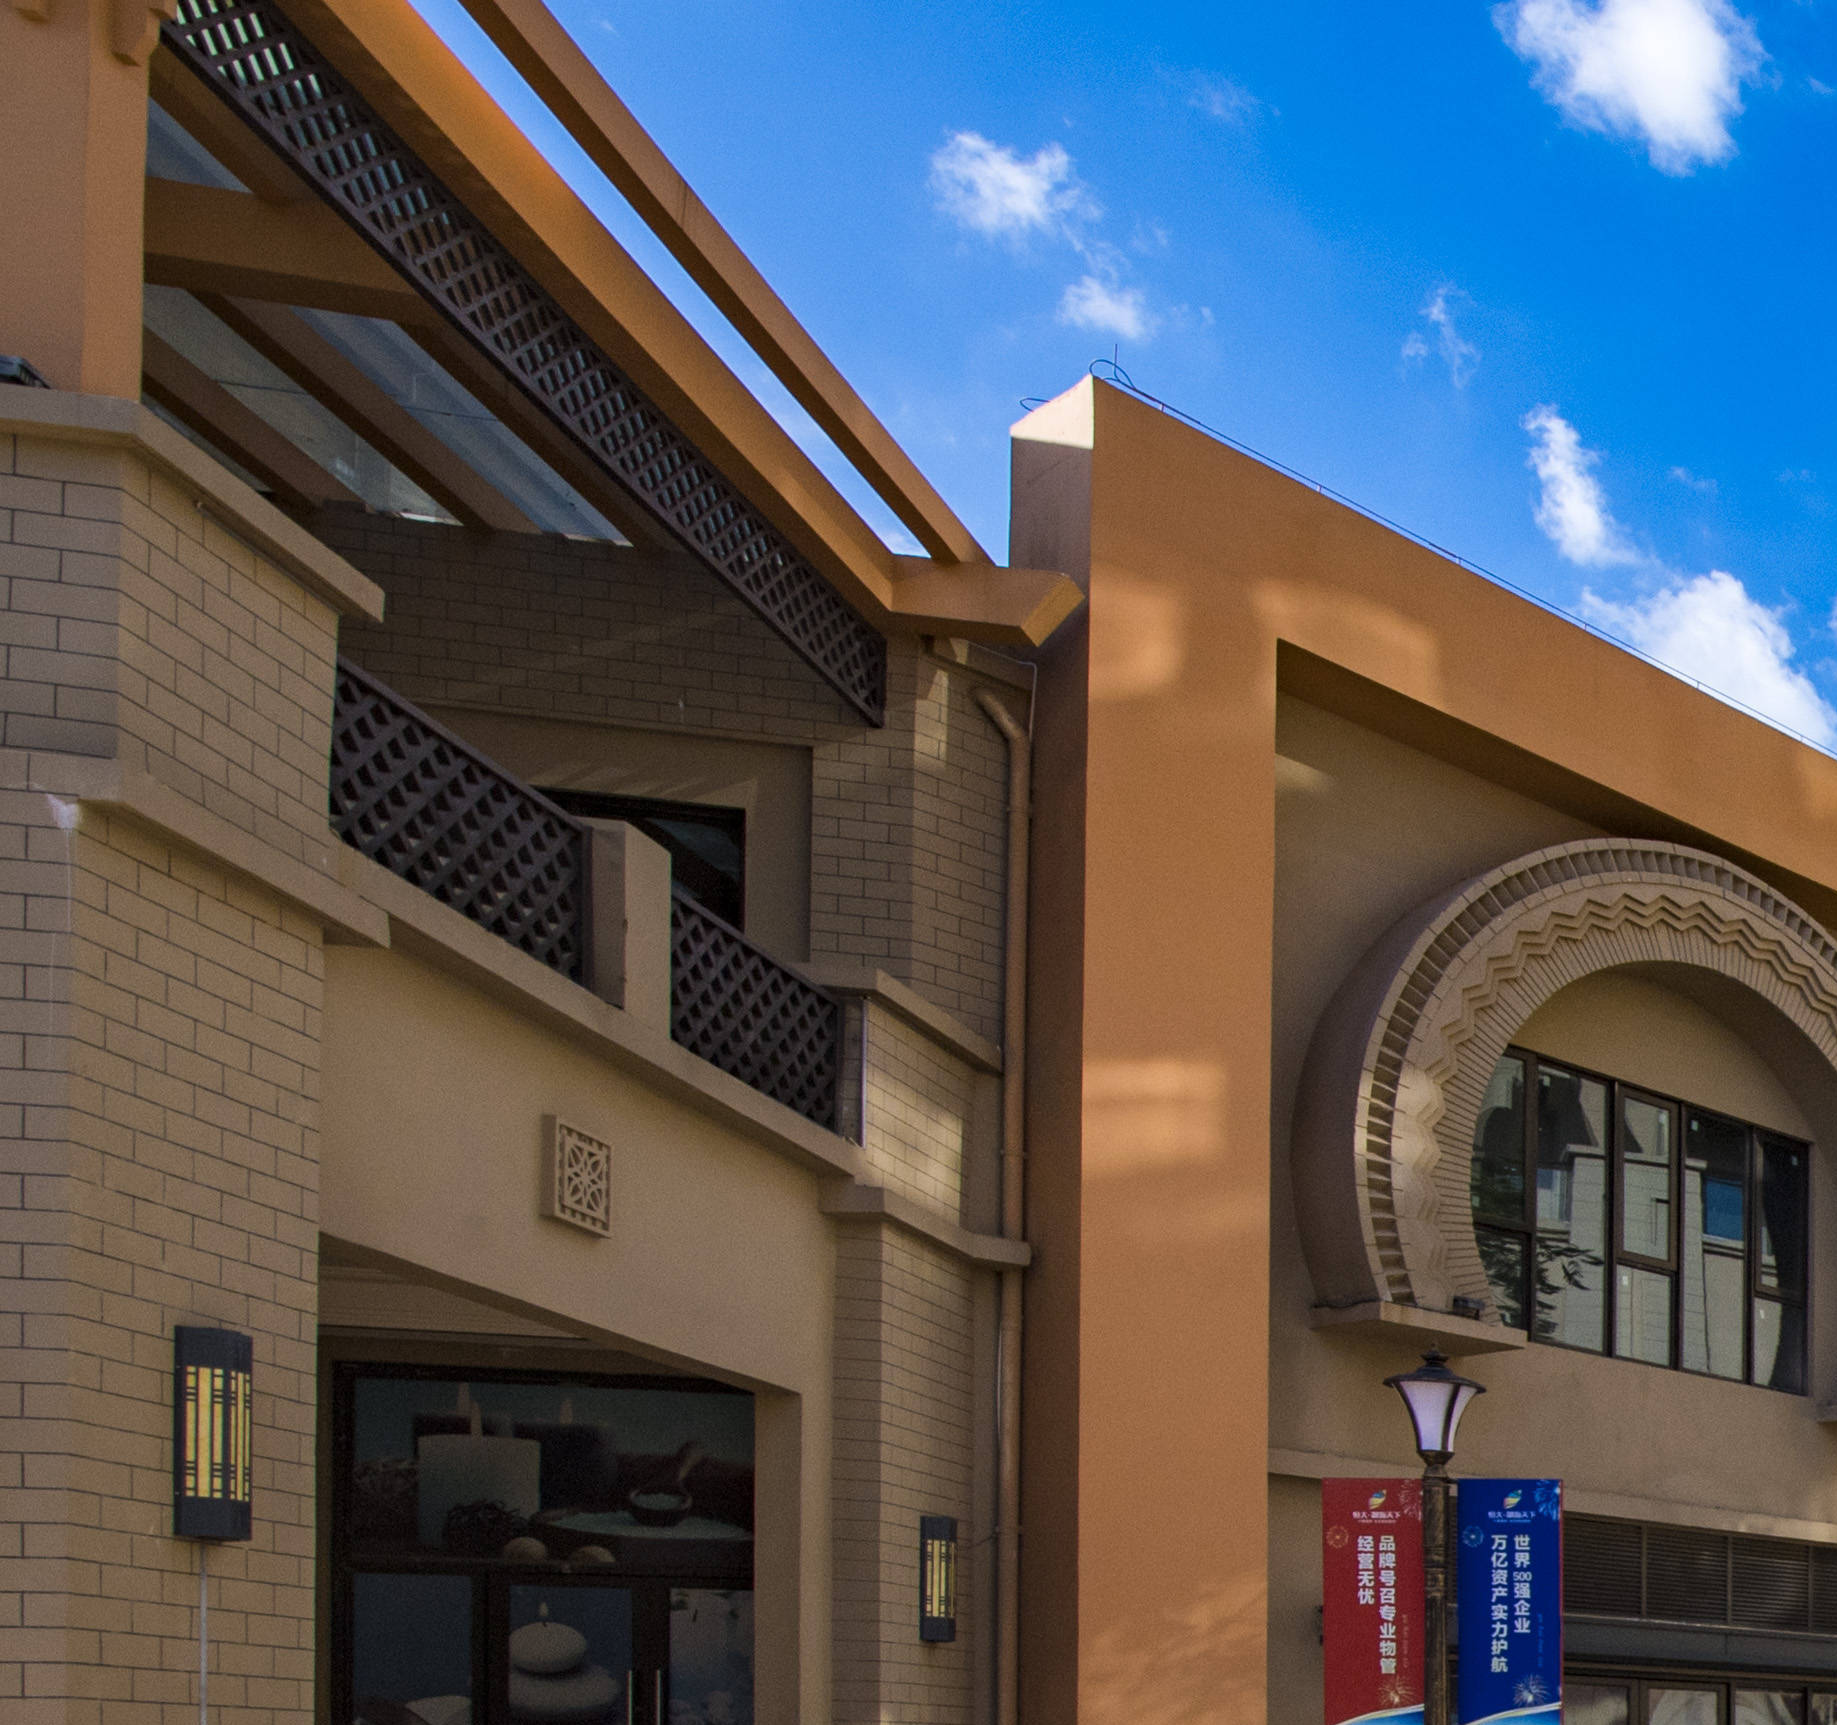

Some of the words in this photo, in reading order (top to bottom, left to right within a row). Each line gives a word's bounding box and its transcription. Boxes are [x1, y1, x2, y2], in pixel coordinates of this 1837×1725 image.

[1357, 1535, 1375, 1605] 经营无忧
[1378, 1535, 1397, 1675] 品牌号召专业物管
[1490, 1535, 1509, 1673] 万亿资产实力护航
